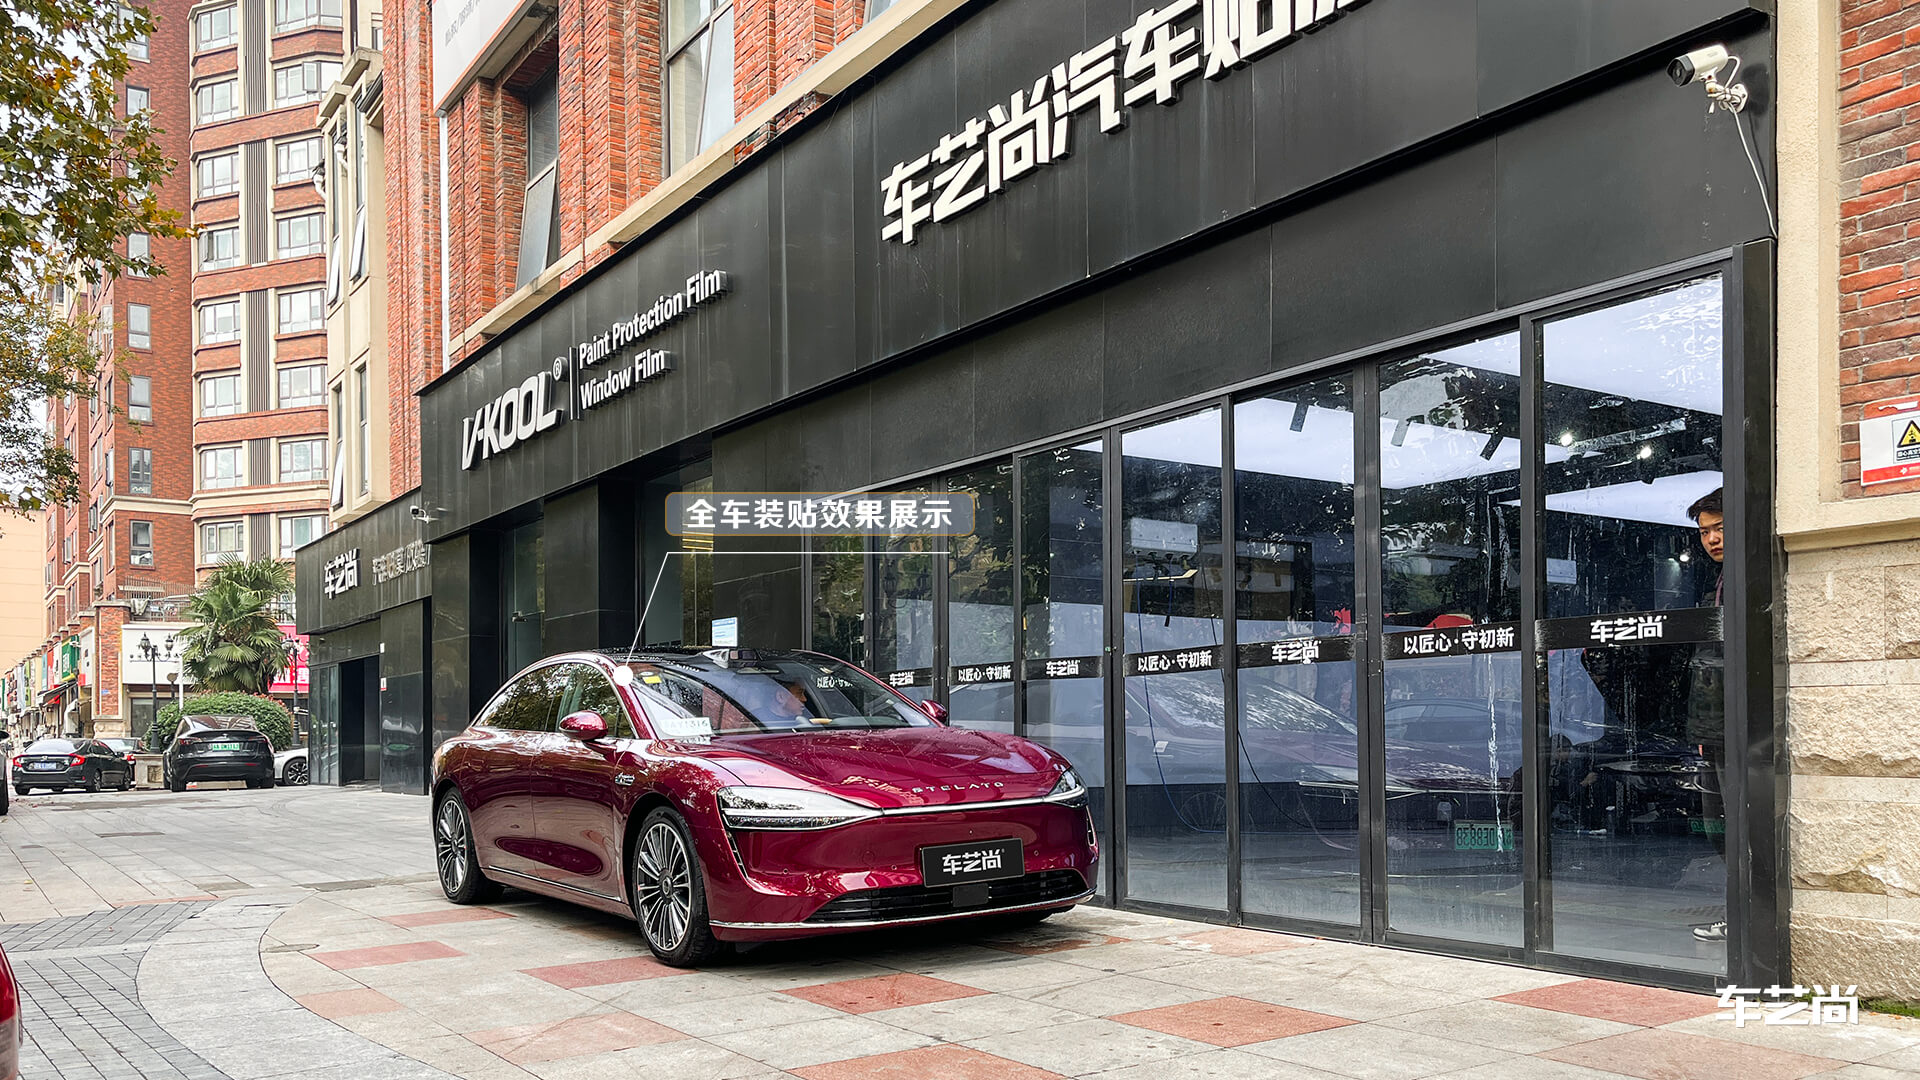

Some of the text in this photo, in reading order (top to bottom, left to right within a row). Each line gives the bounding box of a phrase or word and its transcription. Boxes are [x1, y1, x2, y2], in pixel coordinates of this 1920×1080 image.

[879, 0, 1373, 245] 车艺尚汽车贴
[579, 268, 722, 370] Paint Protection Film
[580, 350, 666, 410] Window Film
[323, 548, 359, 600] 车艺尚
[1402, 627, 1516, 656] 以匠心·守初新
[1589, 614, 1665, 643] 车艺尚
[1137, 650, 1214, 674] 以匠心·守初新
[1270, 640, 1320, 663] 车艺尚
[888, 671, 915, 688] 车艺尚
[1045, 659, 1081, 678] 车艺尚
[911, 781, 1005, 794] STELATO
[941, 847, 1003, 876] 车艺尚
